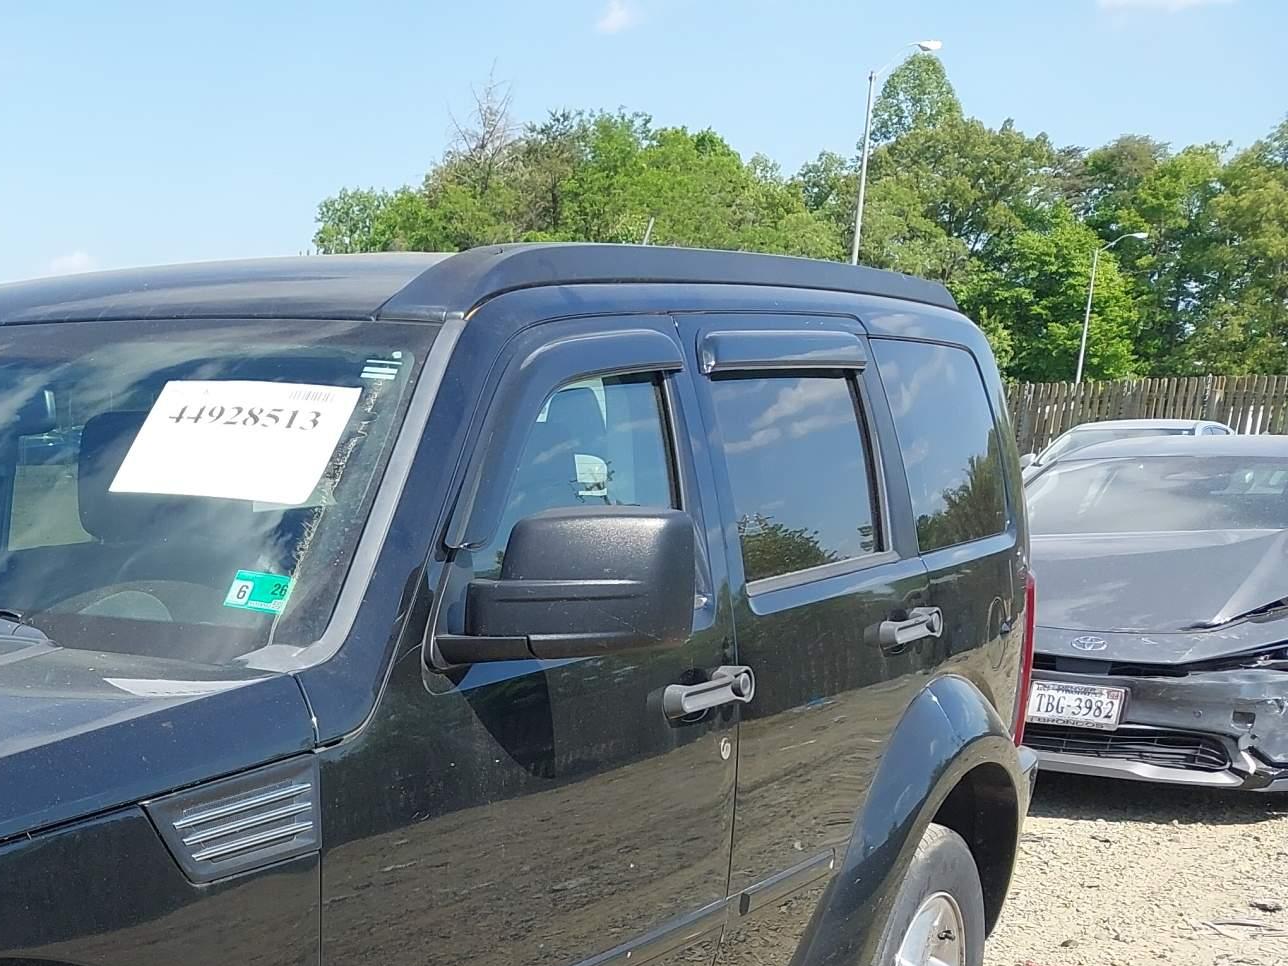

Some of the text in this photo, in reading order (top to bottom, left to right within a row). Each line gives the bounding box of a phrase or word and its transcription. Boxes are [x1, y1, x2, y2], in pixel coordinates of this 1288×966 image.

[169, 404, 322, 431] 44928513
[236, 583, 289, 599] 6 26
[1035, 692, 1115, 719] TBG-3982
